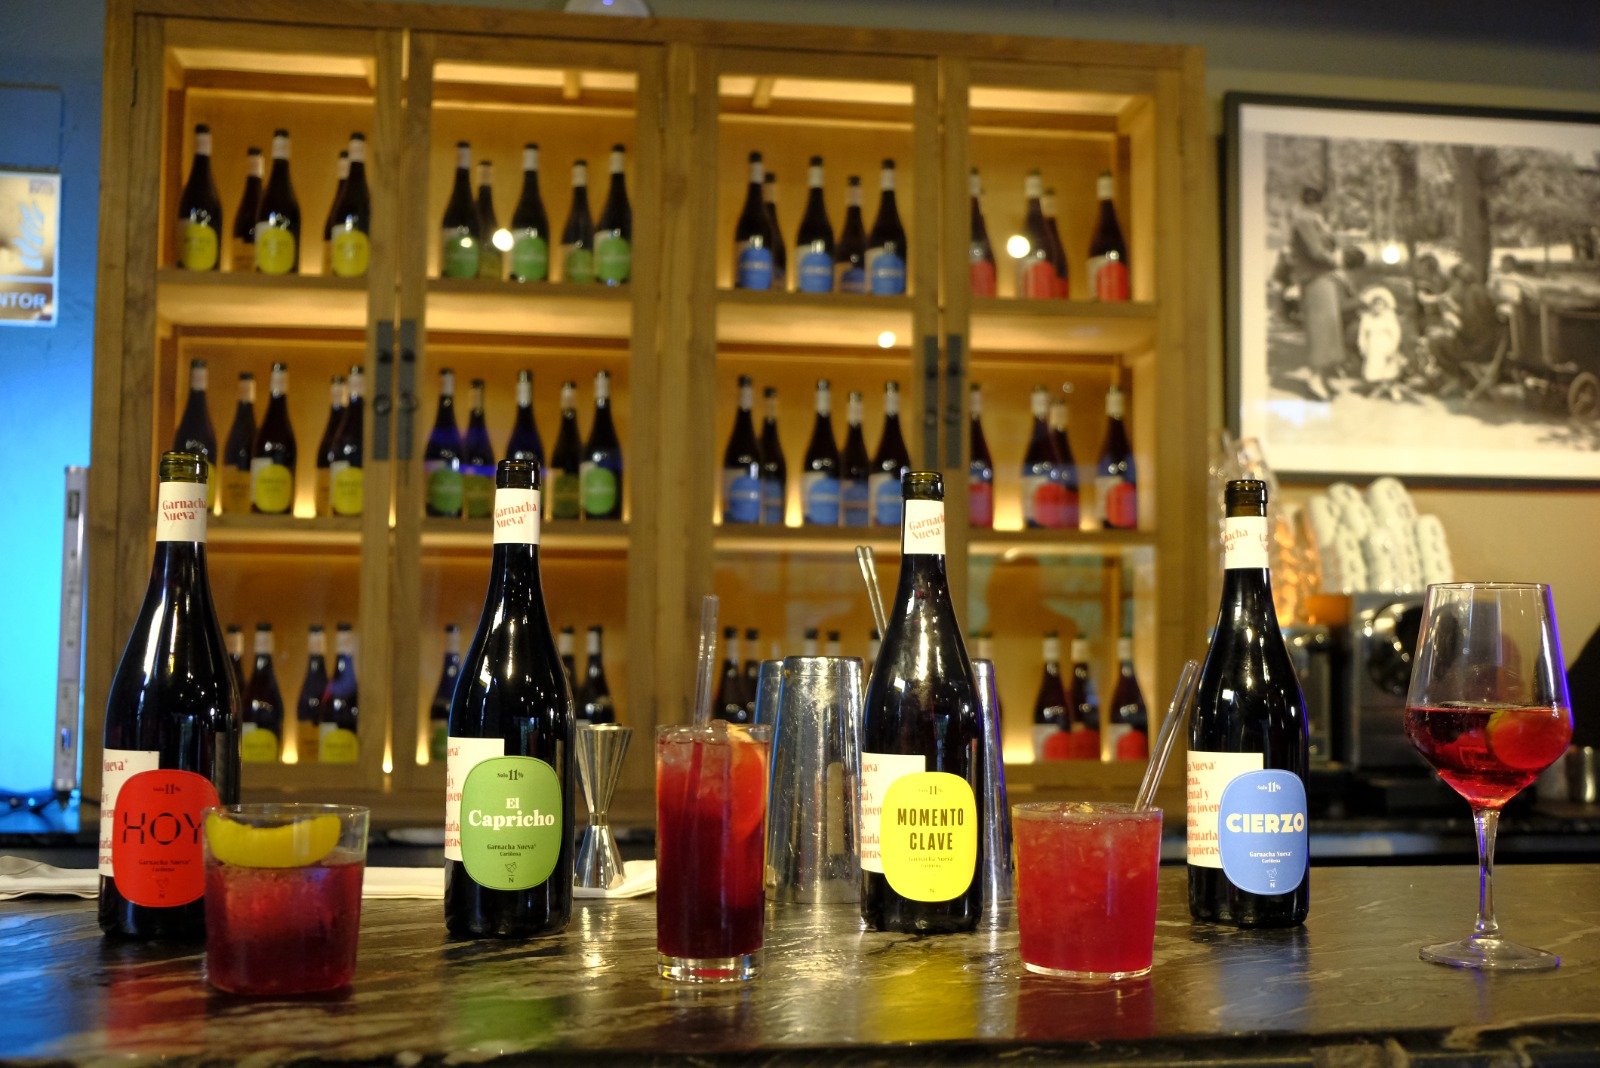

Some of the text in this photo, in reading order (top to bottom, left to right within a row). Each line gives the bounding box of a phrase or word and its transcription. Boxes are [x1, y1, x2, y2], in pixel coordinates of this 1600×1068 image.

[506, 797, 520, 809] El
[468, 809, 555, 831] Capricho
[897, 807, 964, 827] MOMENTO
[1225, 812, 1305, 833] CIERZO
[122, 811, 202, 845] HOY
[909, 832, 953, 850] CLAVE
